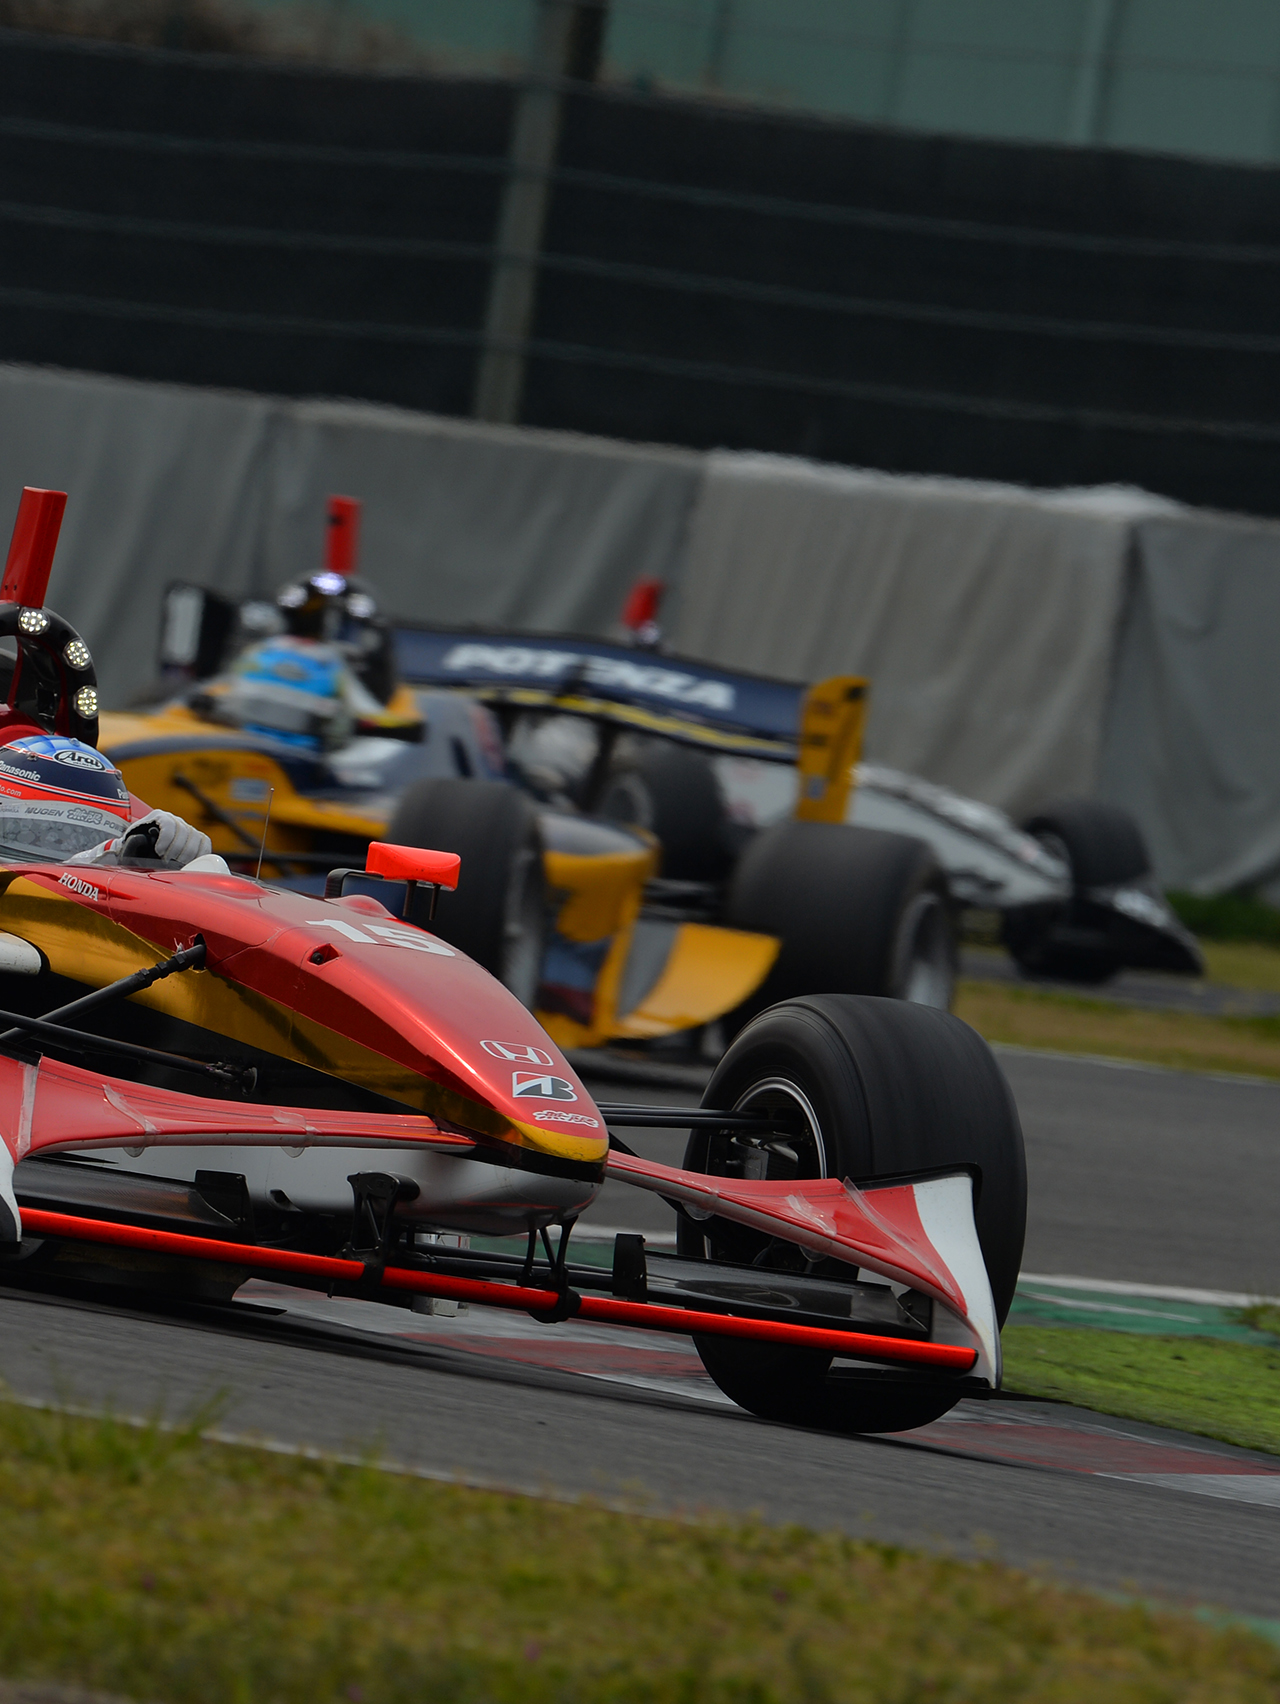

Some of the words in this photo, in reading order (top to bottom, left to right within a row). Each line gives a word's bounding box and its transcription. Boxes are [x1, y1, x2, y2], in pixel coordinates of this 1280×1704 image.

[58, 751, 100, 768] Arai
[24, 806, 64, 817] MUGEN
[58, 872, 99, 901] HONDA
[305, 918, 456, 957] 15
